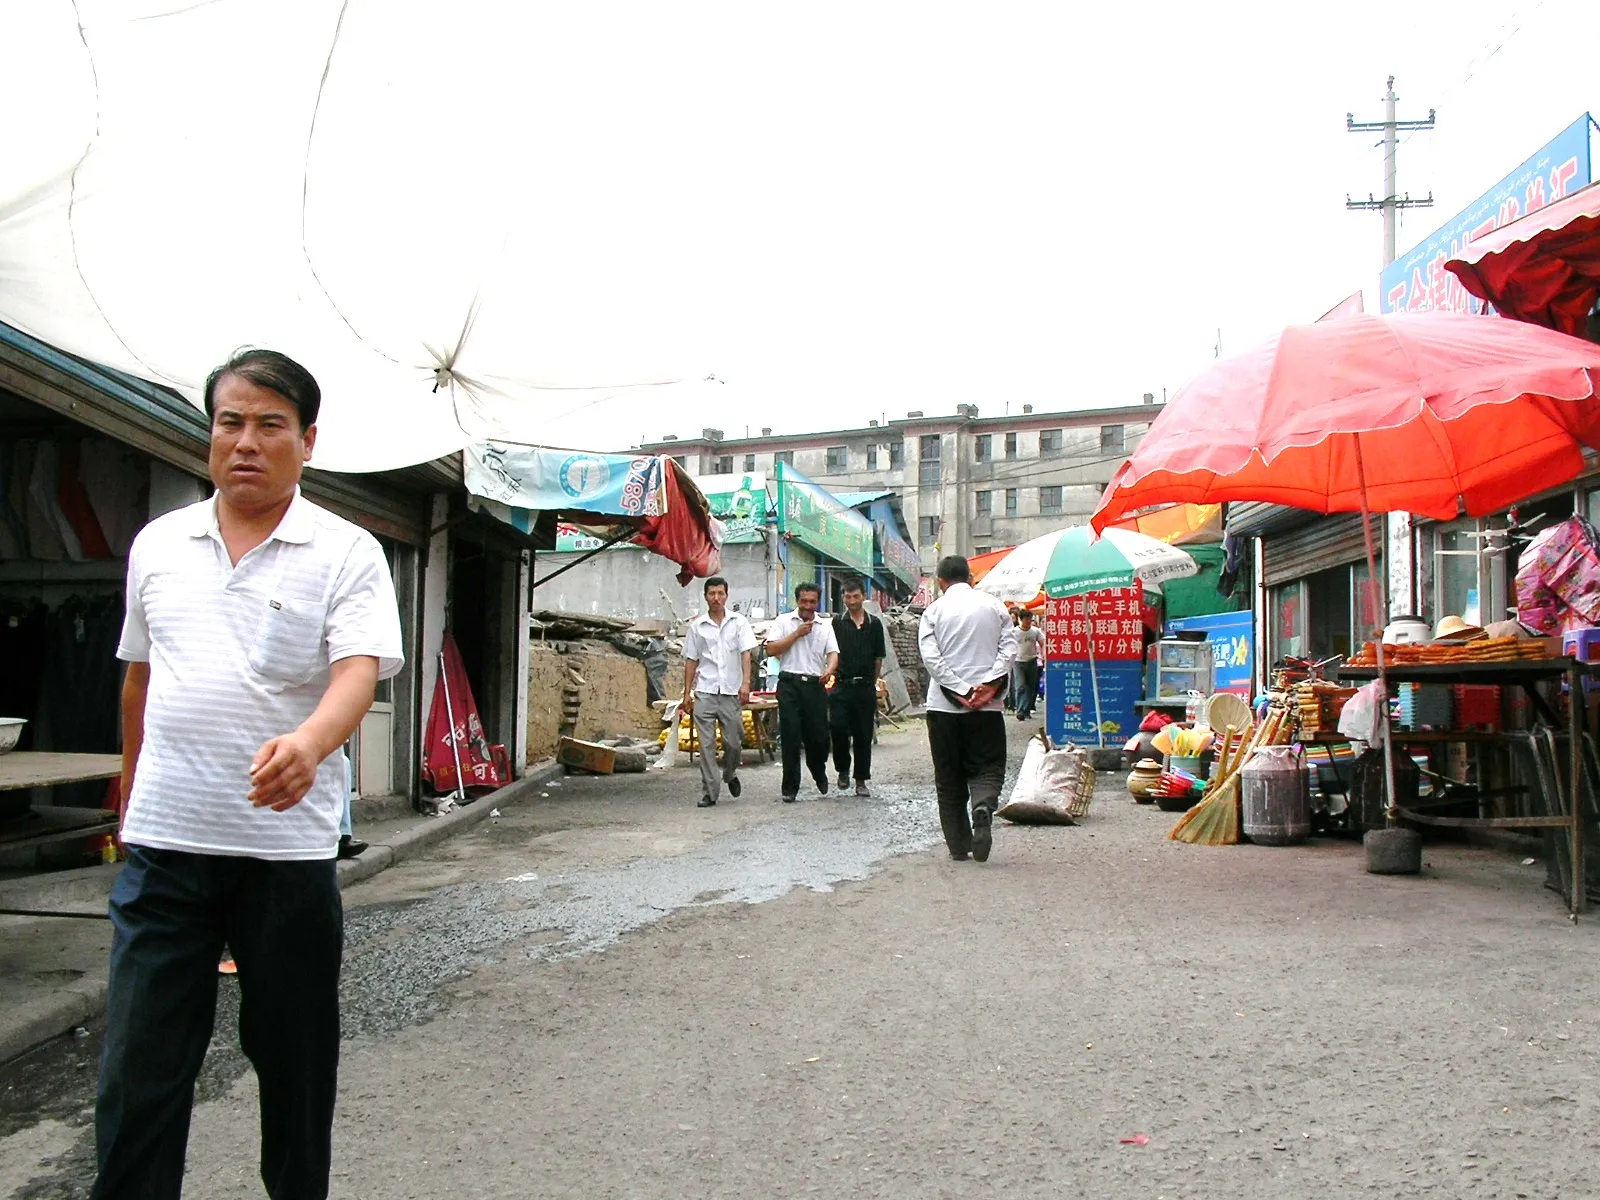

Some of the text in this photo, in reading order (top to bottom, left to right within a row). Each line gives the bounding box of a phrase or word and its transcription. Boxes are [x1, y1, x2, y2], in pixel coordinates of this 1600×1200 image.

[1046, 600, 1140, 616] 高价回收二手机
[1046, 619, 1143, 635] 电信 移动 联通 充值
